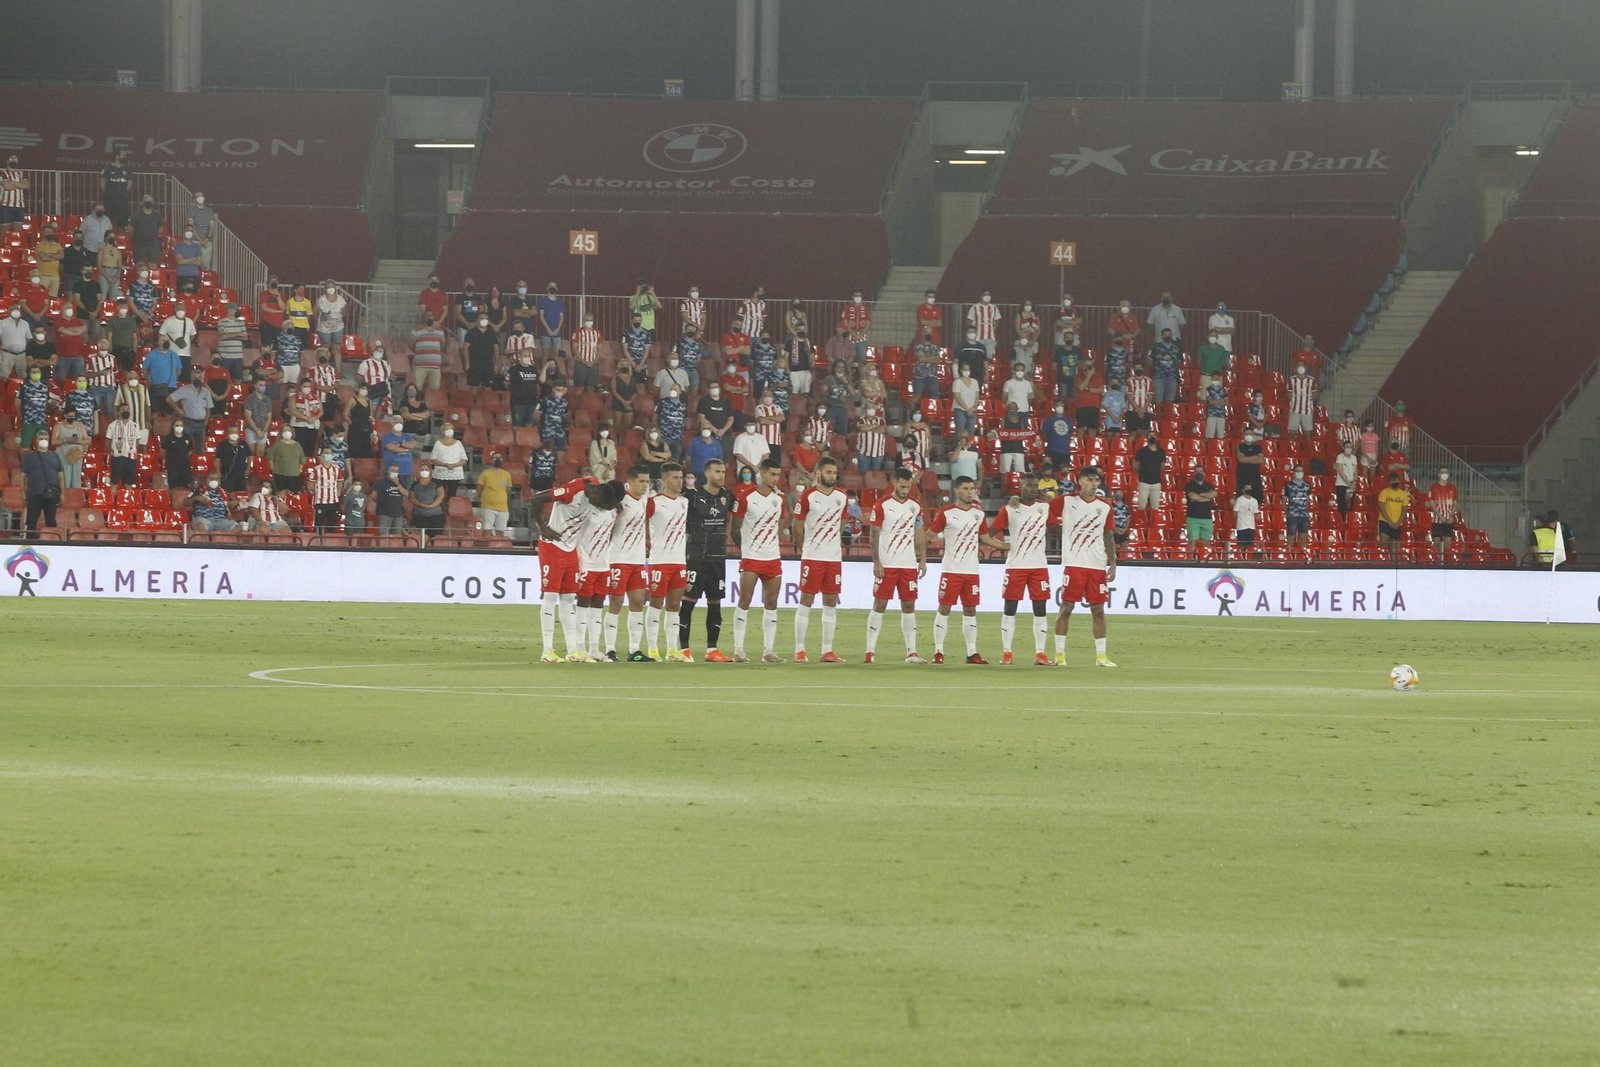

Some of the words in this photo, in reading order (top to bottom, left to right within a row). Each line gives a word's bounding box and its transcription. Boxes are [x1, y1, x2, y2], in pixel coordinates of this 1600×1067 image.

[117, 77, 135, 86] 145
[665, 86, 682, 95] 144
[1284, 89, 1301, 98] 143
[662, 126, 735, 141] BMW
[58, 133, 305, 156] DEKTON
[149, 160, 259, 169] COSENTINO
[1149, 148, 1390, 173] CaixaBank
[548, 174, 720, 189] Automotor
[730, 175, 816, 188] Costa
[573, 234, 596, 252] 45
[1053, 245, 1073, 262] 44
[543, 565, 550, 577] 9
[610, 568, 621, 581] 12
[651, 569, 662, 583] 10
[803, 565, 810, 578] 3
[61, 564, 233, 595] ALMERÍA
[939, 577, 948, 590] 5
[441, 575, 544, 600] COST
[1255, 583, 1406, 612] ALMERÍA
